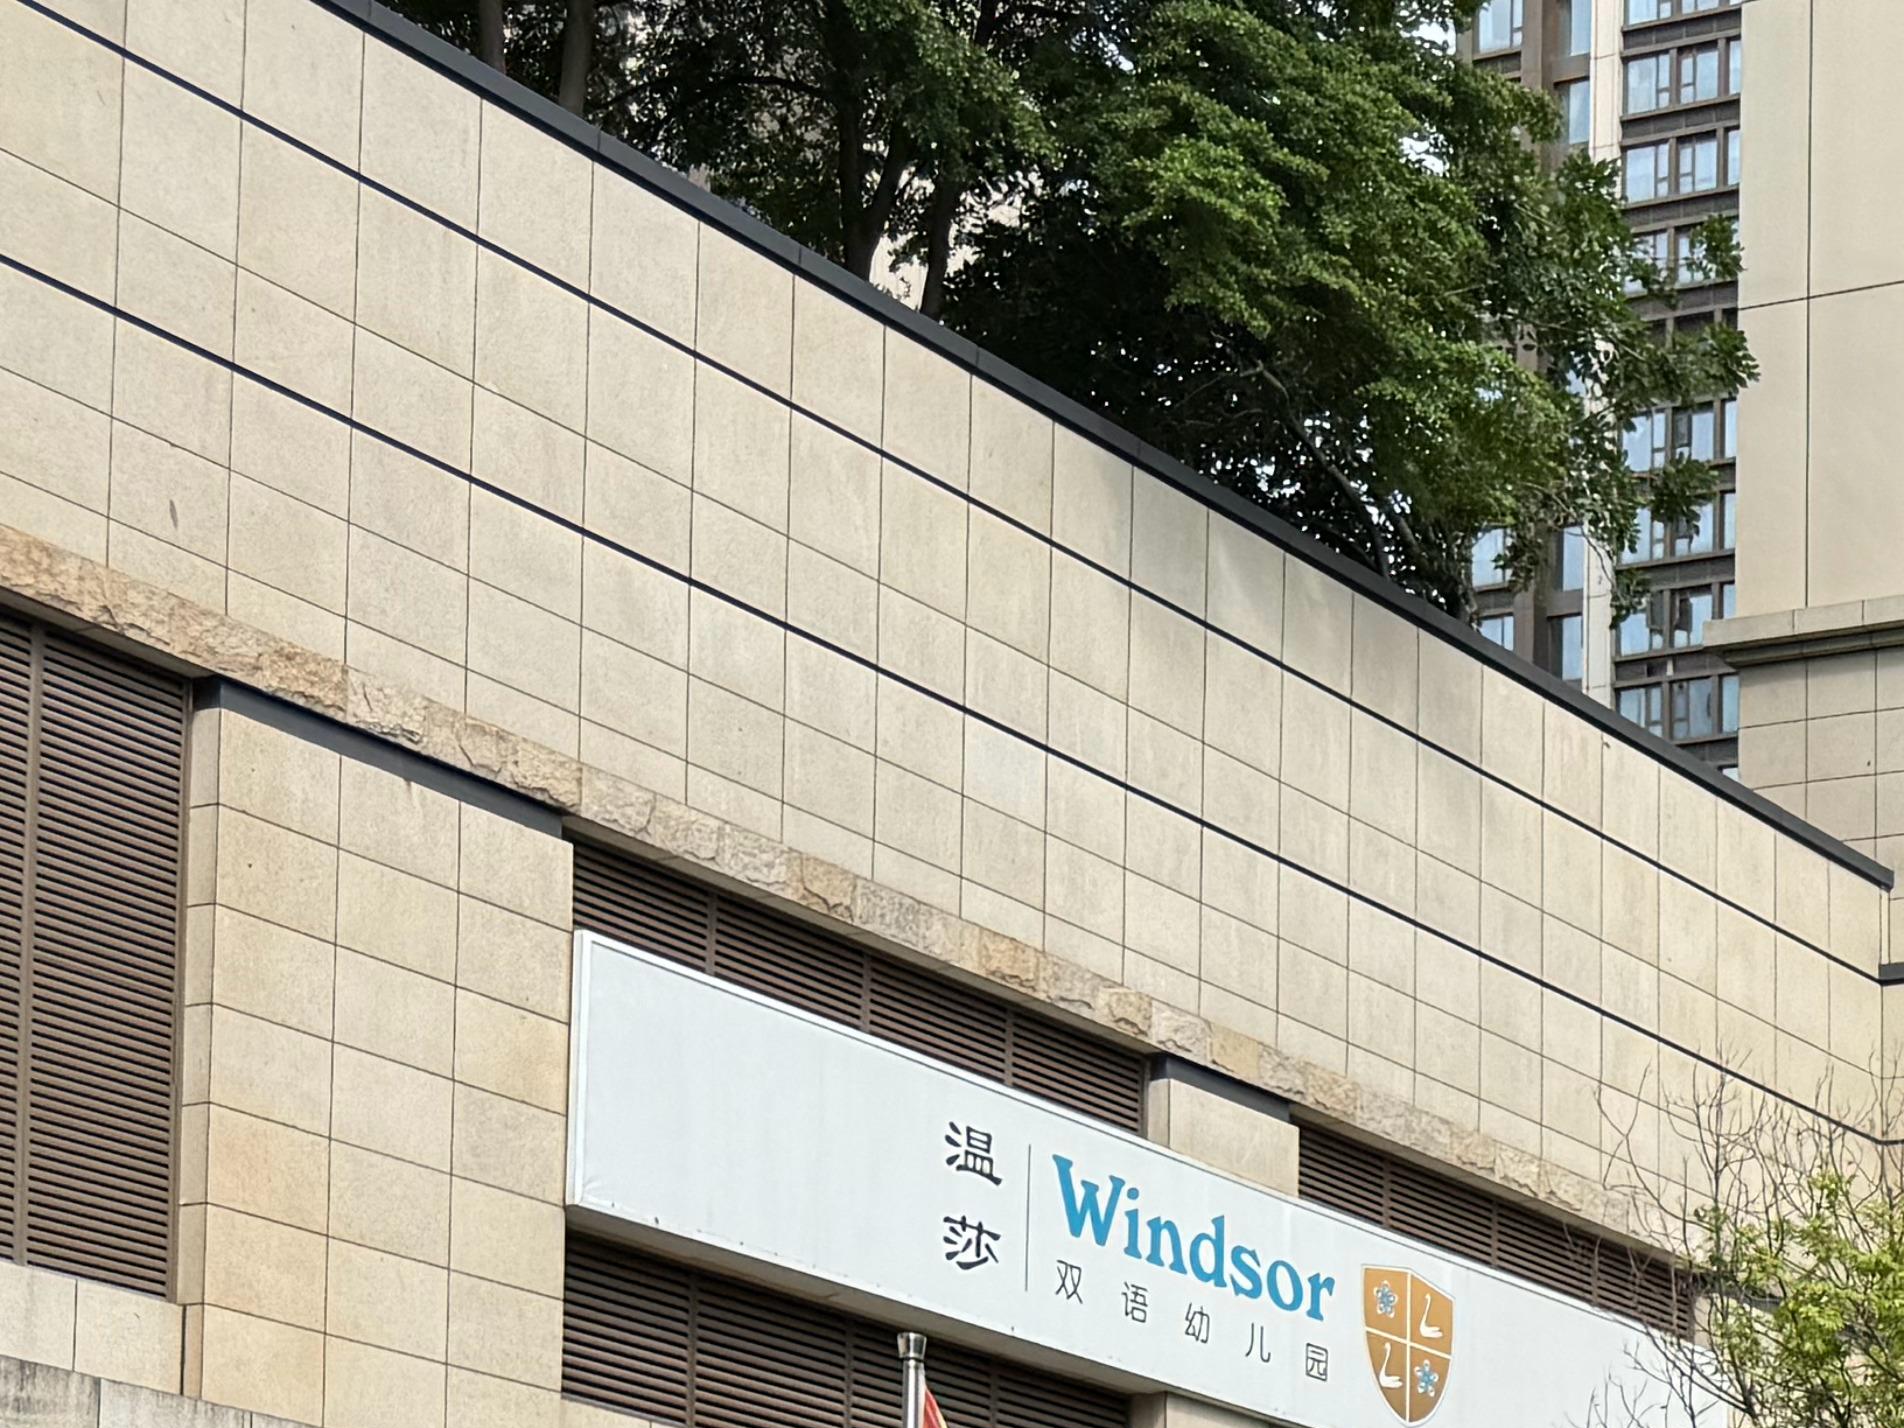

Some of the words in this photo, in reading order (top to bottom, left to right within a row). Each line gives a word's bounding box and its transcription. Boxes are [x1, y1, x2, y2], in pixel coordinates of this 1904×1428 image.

[943, 1121, 1003, 1270] 温莎
[1052, 1154, 1335, 1321] Windsor
[1055, 1260, 1328, 1382] 双语幼儿园
